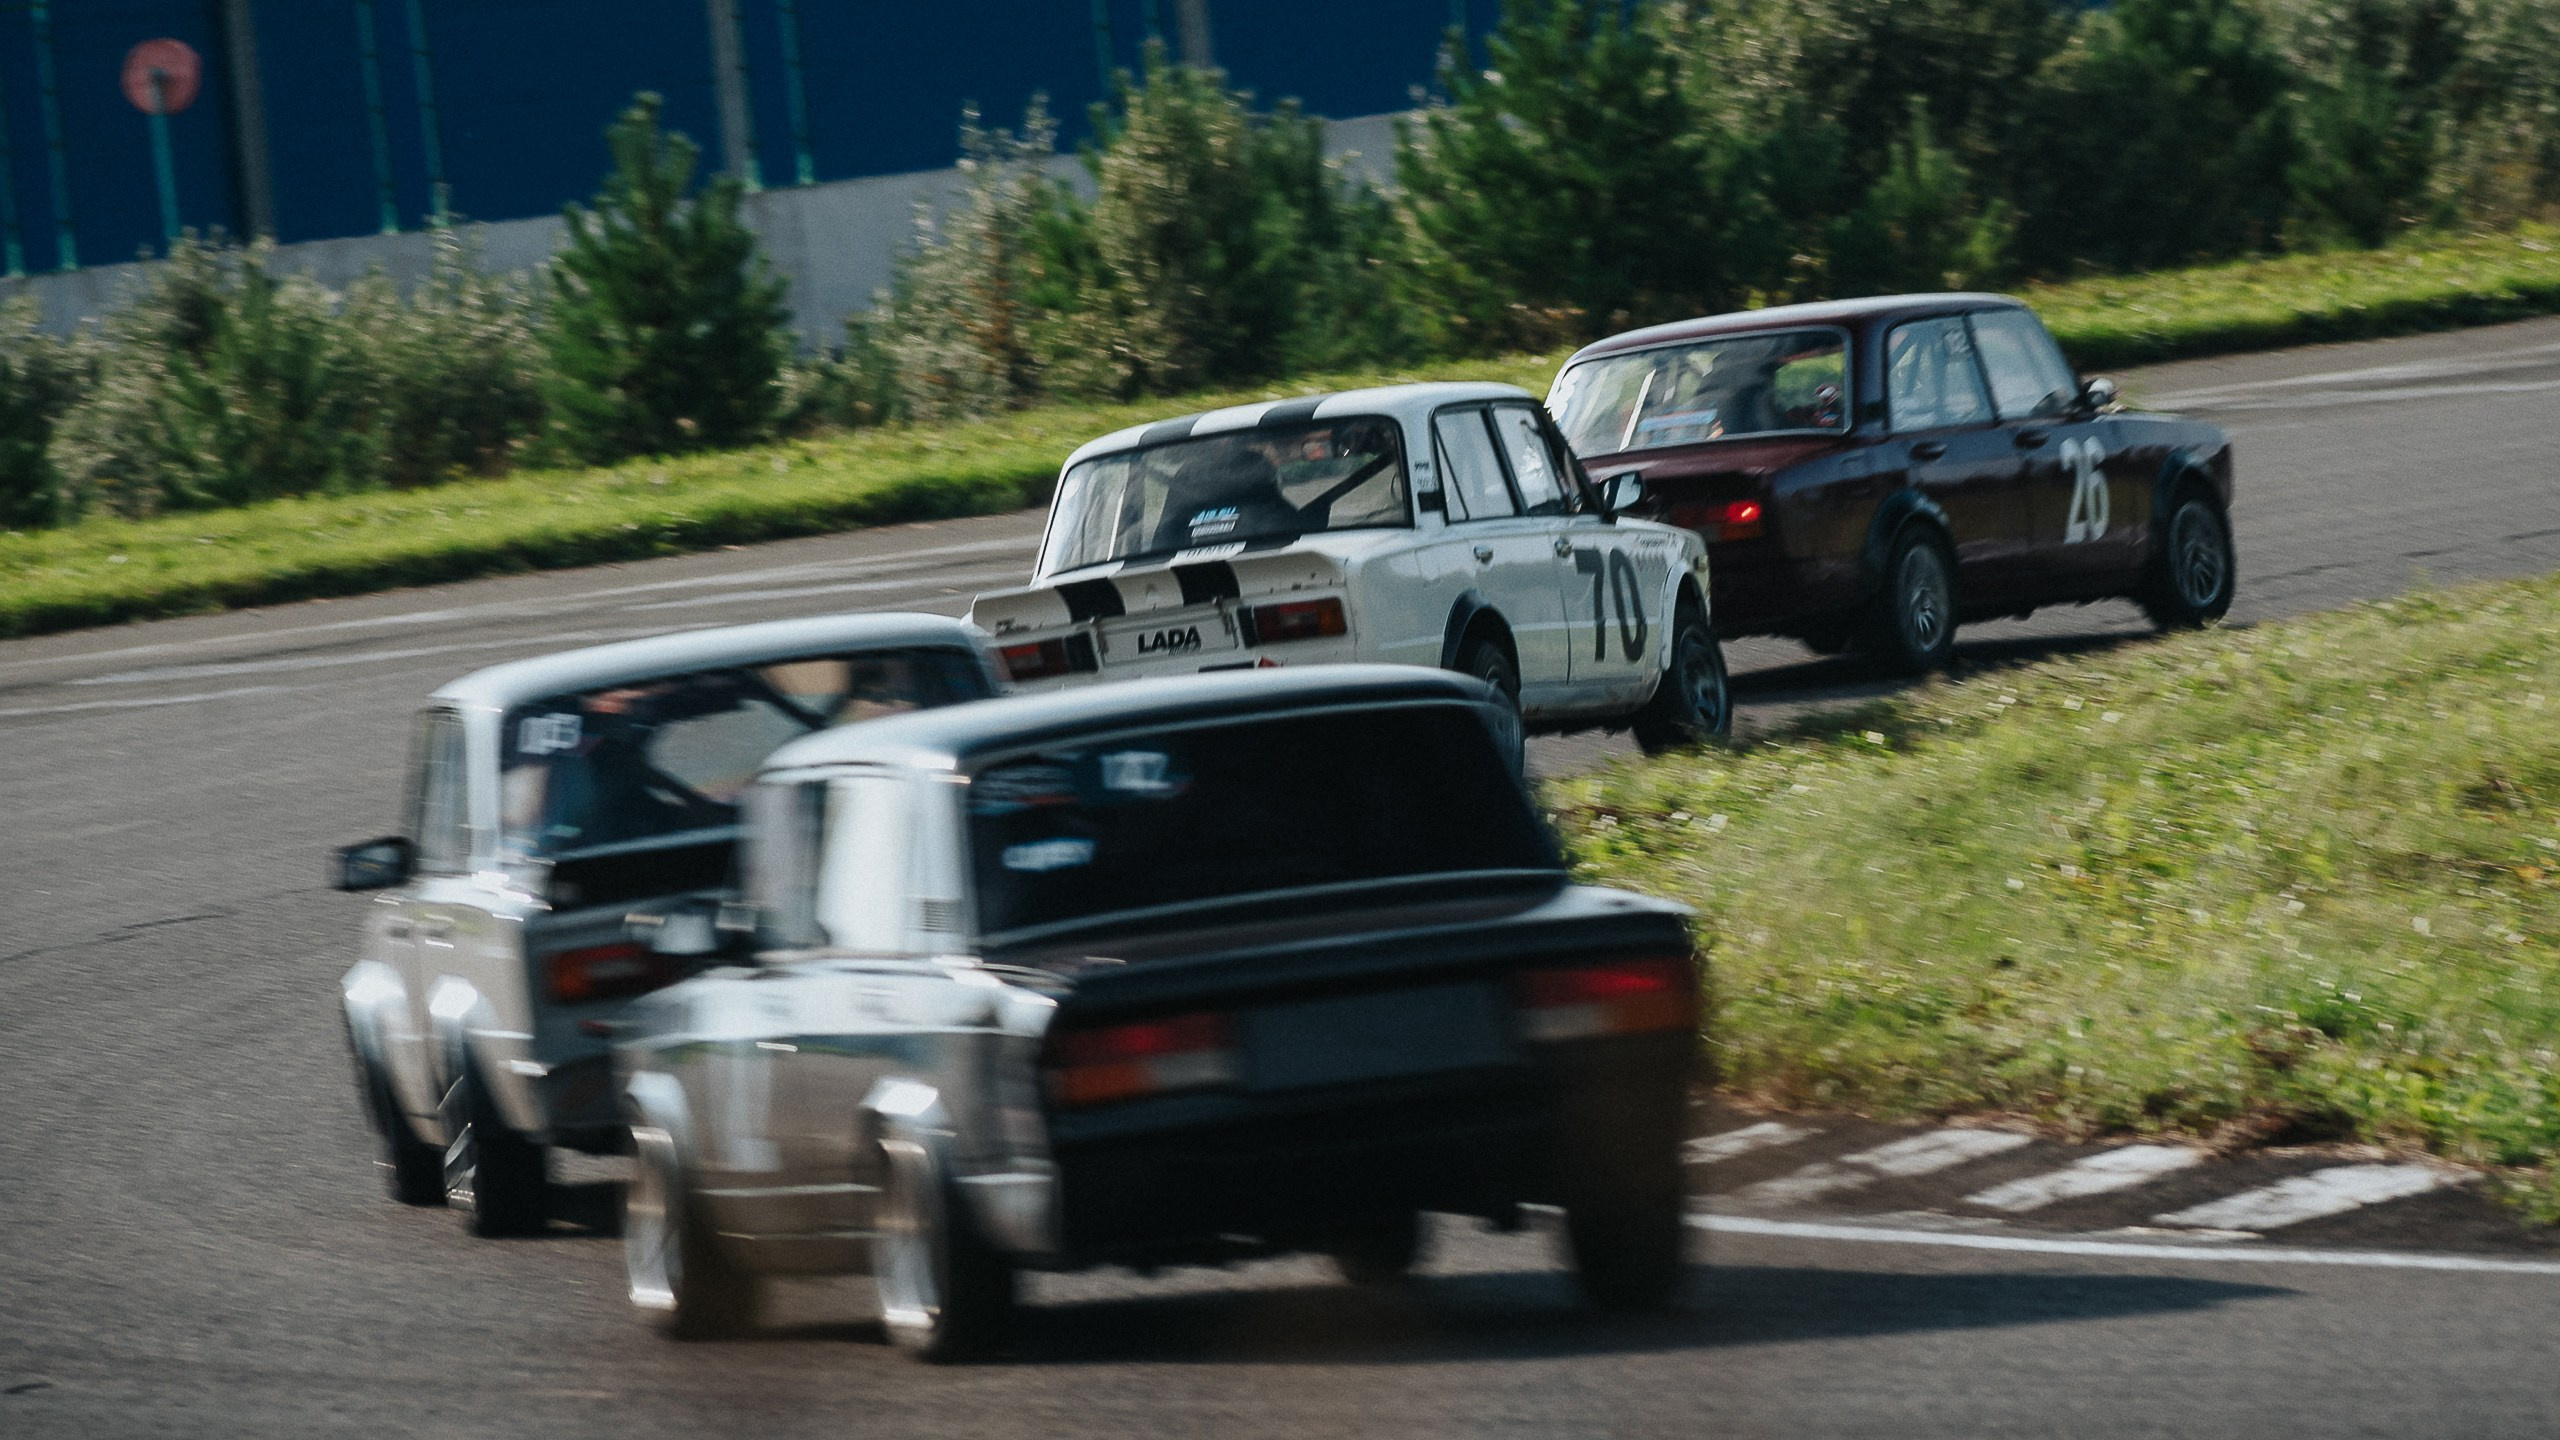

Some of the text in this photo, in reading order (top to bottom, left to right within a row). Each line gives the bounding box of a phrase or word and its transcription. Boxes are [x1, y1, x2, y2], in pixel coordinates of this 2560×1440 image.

[2060, 436, 2110, 544] 26
[1137, 625, 1202, 656] LADA
[1573, 548, 1648, 663] 70
